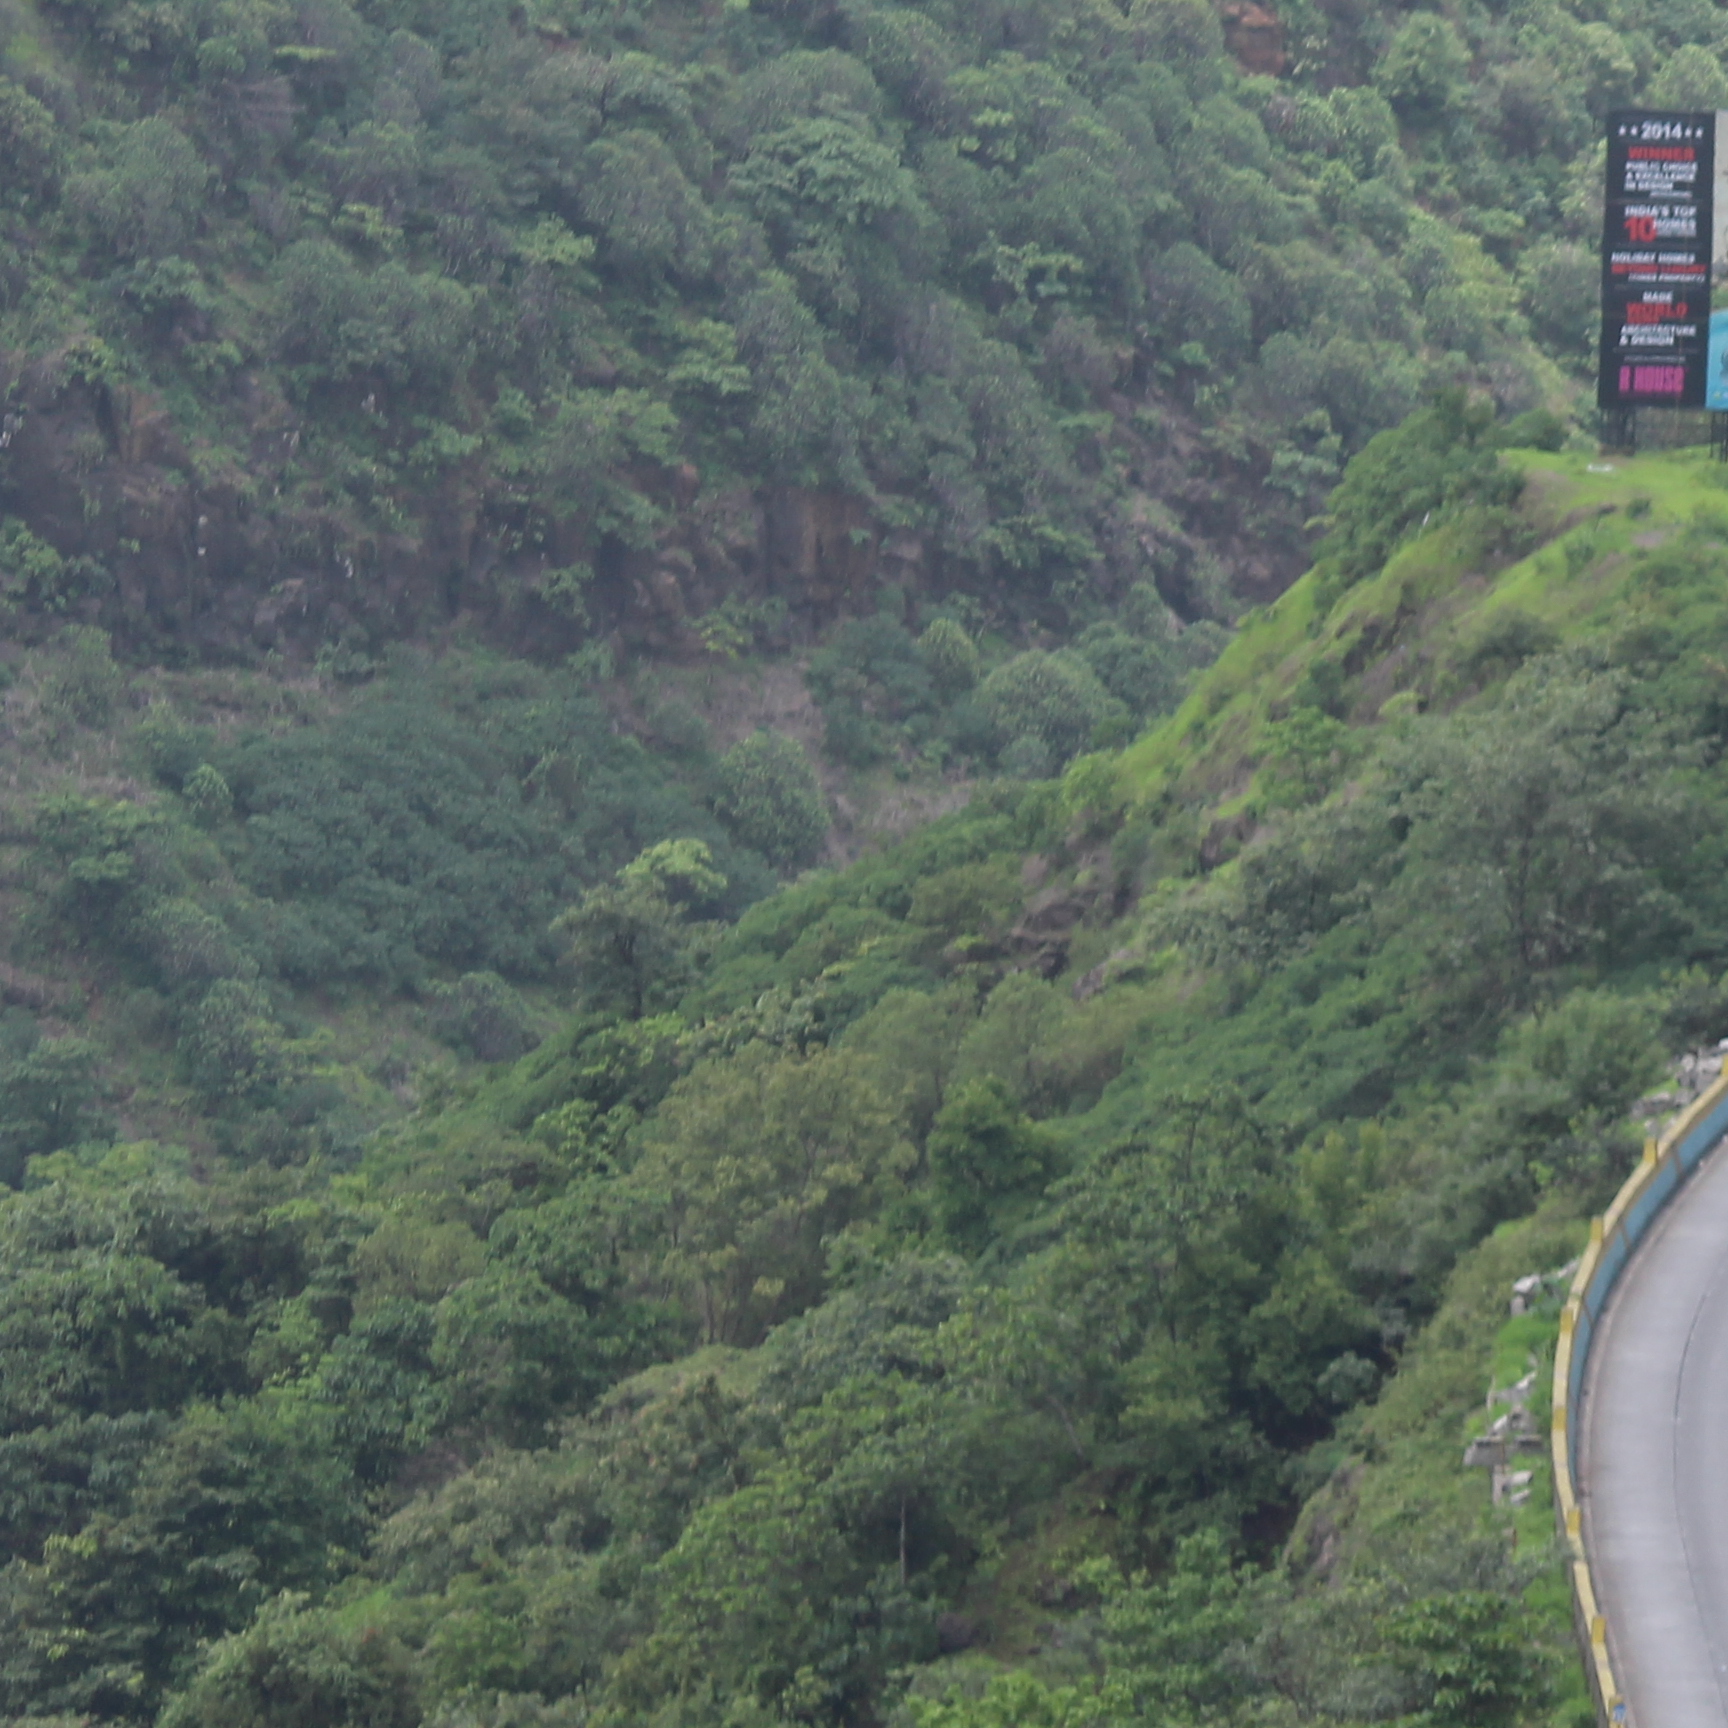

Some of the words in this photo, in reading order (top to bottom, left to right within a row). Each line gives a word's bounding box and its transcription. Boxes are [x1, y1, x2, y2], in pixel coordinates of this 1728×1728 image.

[1641, 120, 1682, 140] 2014
[1628, 146, 1695, 161] WINNER
[1673, 205, 1697, 217] TOP
[1623, 216, 1657, 243] 10
